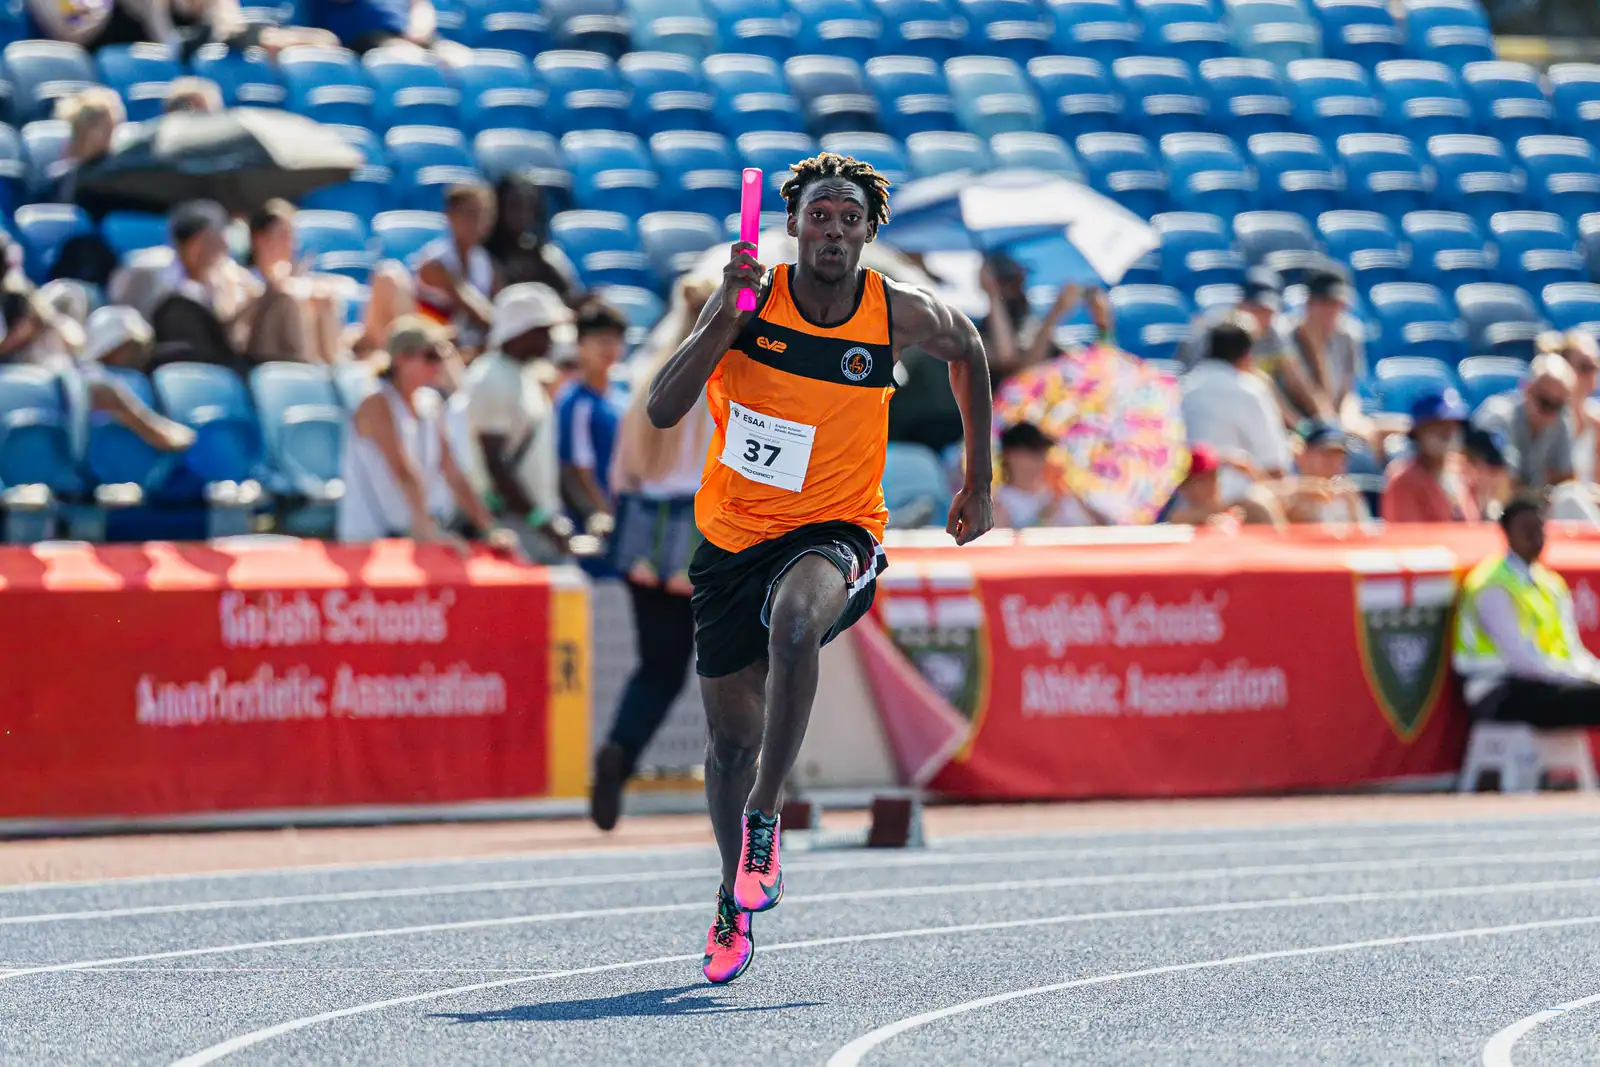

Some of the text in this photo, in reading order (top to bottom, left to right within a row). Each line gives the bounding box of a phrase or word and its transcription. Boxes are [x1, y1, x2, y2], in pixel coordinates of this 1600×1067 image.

[743, 414, 765, 428] ESAA
[743, 439, 782, 467] 37
[1001, 593, 1105, 659] English
[330, 660, 507, 719] Association
[1021, 657, 1287, 718] Athletic Association
